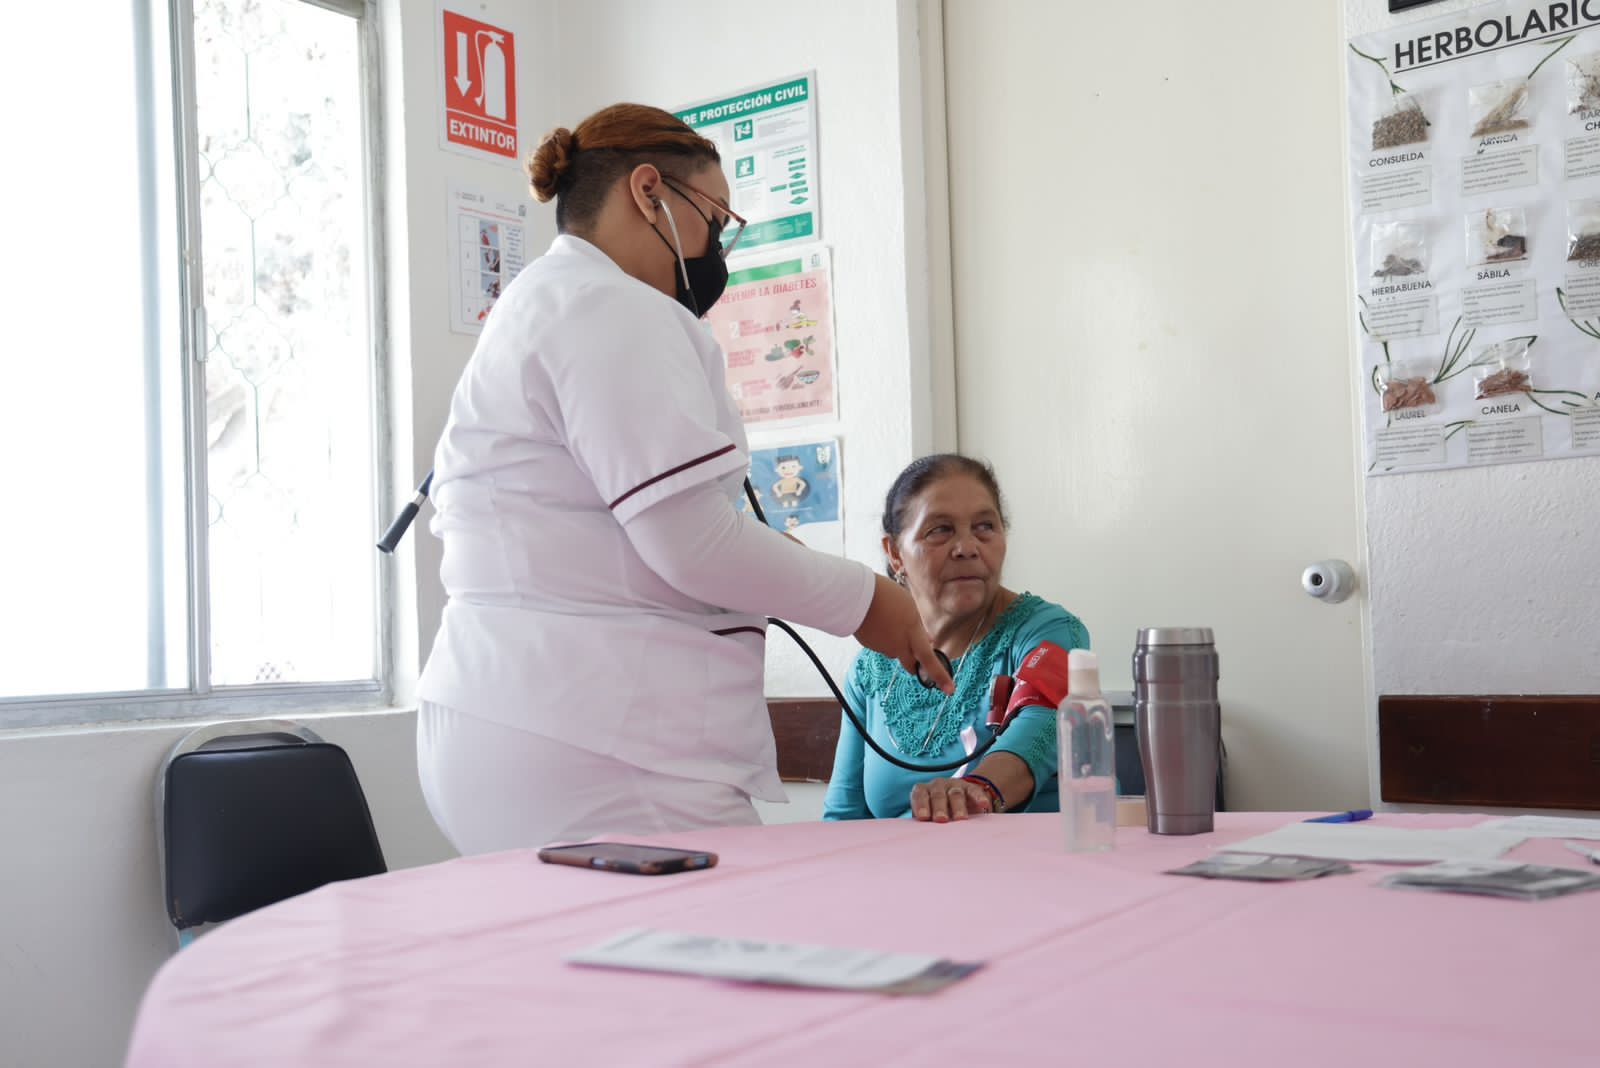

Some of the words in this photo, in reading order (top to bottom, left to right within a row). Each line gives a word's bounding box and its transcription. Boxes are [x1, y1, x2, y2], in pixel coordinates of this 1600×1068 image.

[683, 113, 697, 125] DE
[700, 93, 772, 122] PROTECCIÓN
[774, 84, 806, 102] CIVIL
[449, 119, 515, 152] EXTINTOR
[1369, 151, 1424, 167] CONSUELDA
[759, 284, 770, 297] LA
[773, 277, 817, 295] DIABETES
[1371, 280, 1432, 297] HIERBABUENA
[1395, 409, 1426, 421] LAUREL
[1481, 404, 1520, 415] CANELA
